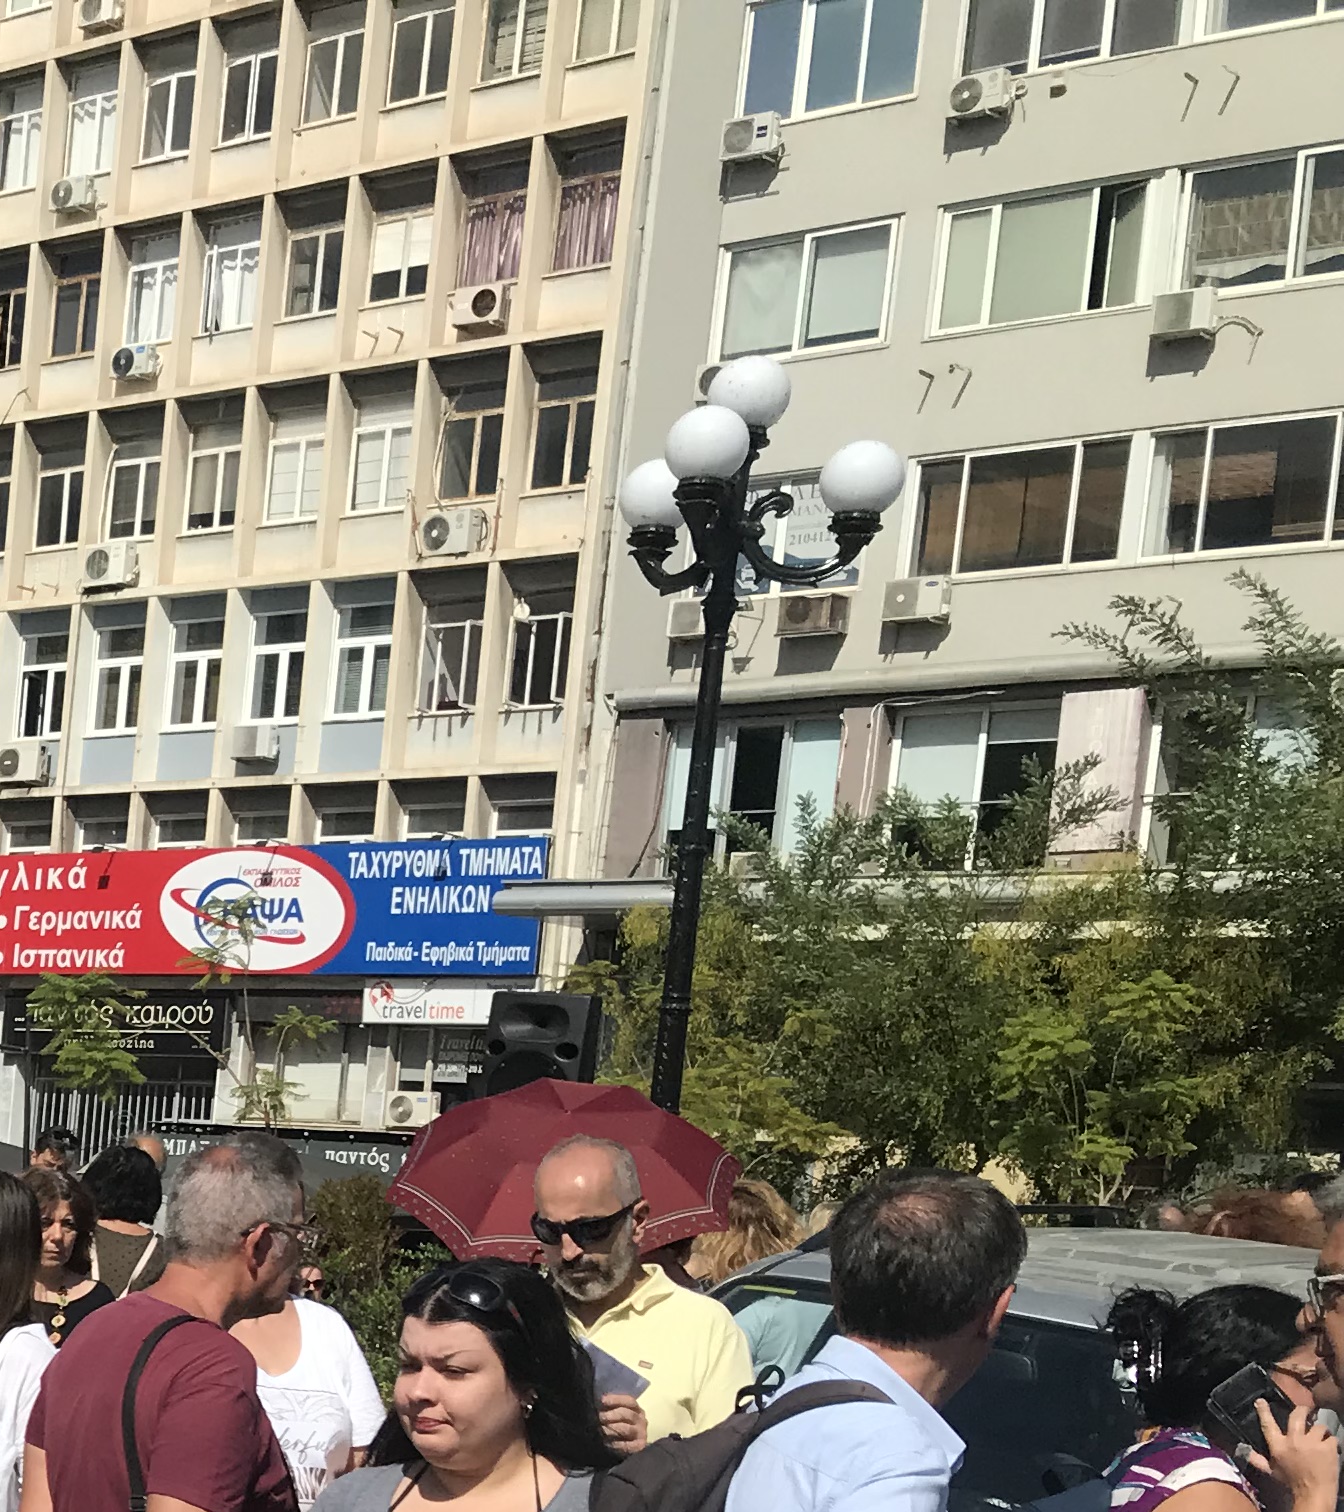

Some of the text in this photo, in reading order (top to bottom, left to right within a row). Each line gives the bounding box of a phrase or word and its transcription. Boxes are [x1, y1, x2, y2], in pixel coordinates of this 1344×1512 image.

[348, 846, 543, 879] ΤΑΧΥΡΥΘΜΑ ΤΜΗΜΑΤΑ
[390, 885, 491, 914] ΕΝΗΛΙΚΩΝ
[13, 903, 143, 936] Γερμανικά
[12, 942, 125, 968] Ισπανικά
[421, 941, 474, 966] Εφηβικά
[477, 941, 530, 967] Τμήματα
[125, 999, 214, 1029] καιρού
[325, 1147, 390, 1173] παντός
